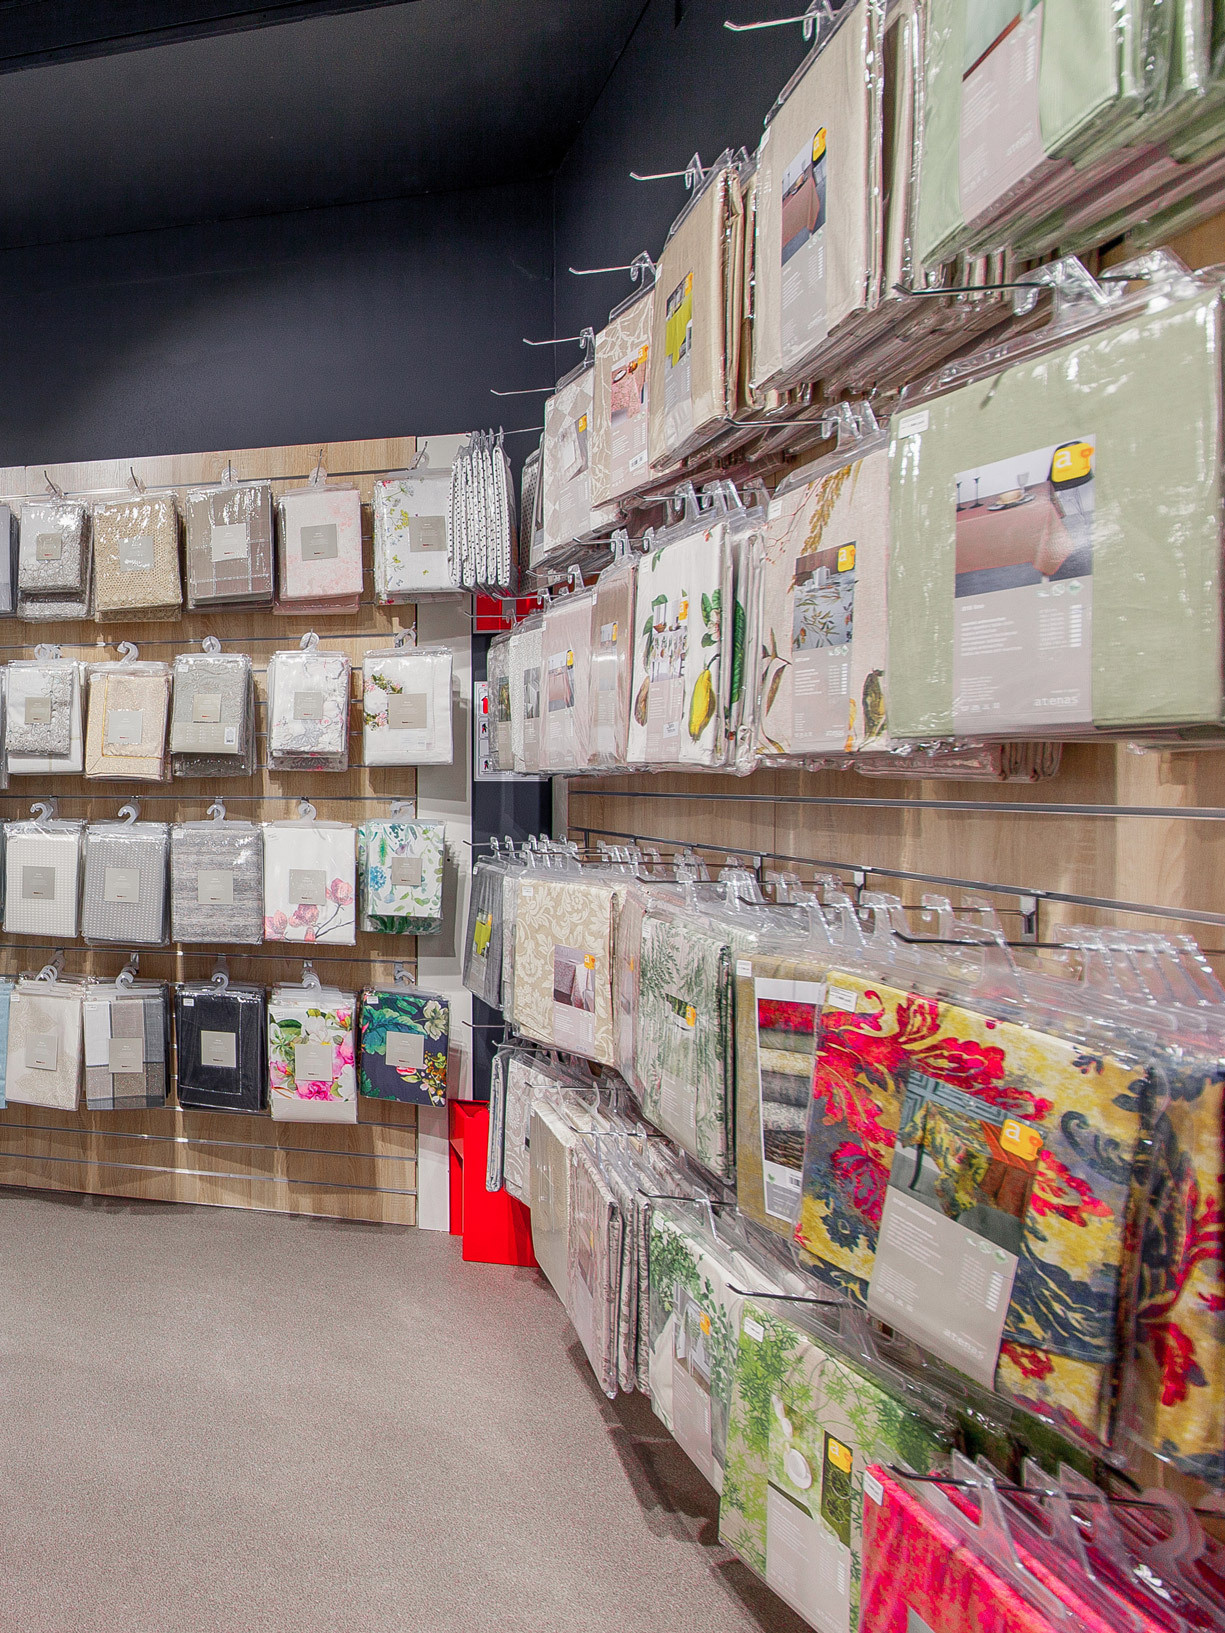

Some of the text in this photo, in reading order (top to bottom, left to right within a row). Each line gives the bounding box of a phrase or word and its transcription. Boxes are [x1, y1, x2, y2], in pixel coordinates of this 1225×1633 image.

[1055, 449, 1073, 468] a
[839, 549, 848, 562] a
[1032, 696, 1079, 707] atenas
[1005, 1122, 1021, 1142] a
[830, 1441, 840, 1457] a
